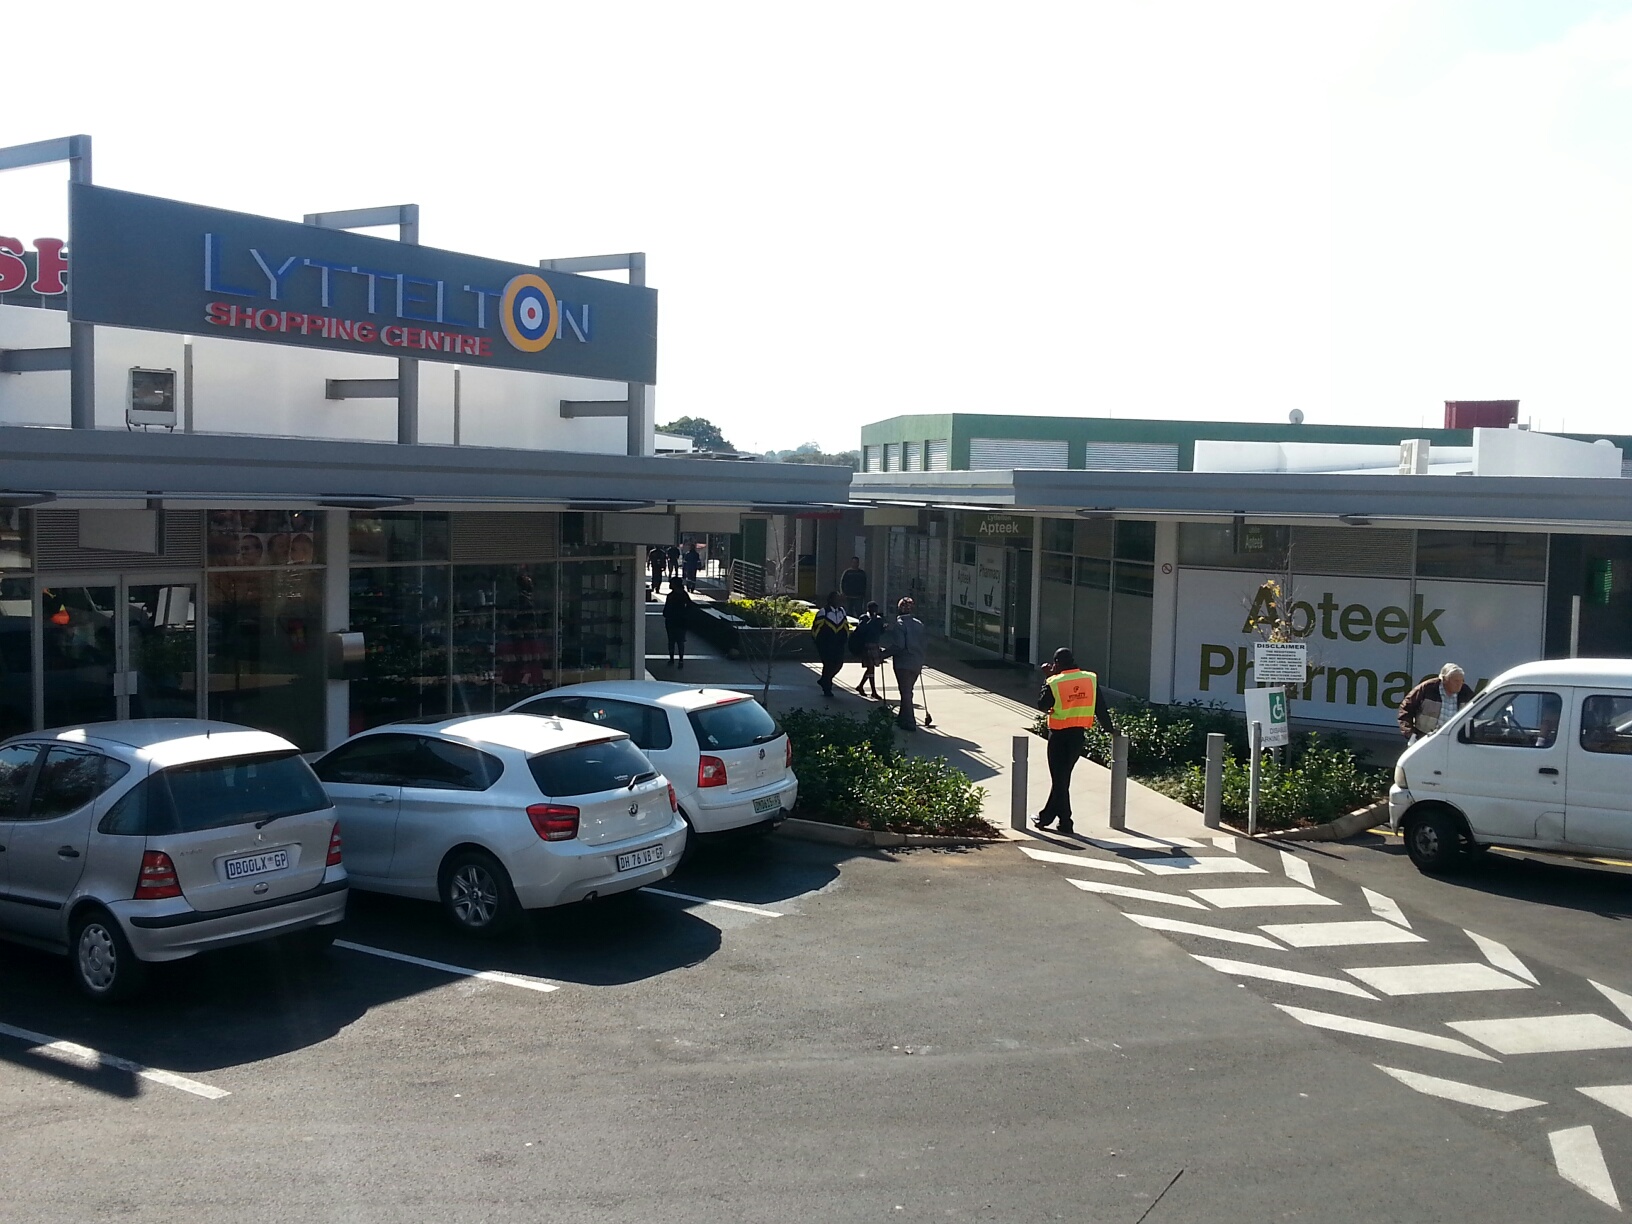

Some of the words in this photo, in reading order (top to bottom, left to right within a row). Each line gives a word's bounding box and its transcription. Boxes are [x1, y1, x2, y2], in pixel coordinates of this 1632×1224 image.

[205, 233, 592, 353] LYTTELTON
[205, 301, 379, 343] SHOPPING
[380, 324, 494, 356] CENTRE
[979, 520, 1019, 535] Apteek
[1199, 643, 1489, 710] Phrma
[274, 853, 286, 867] GP
